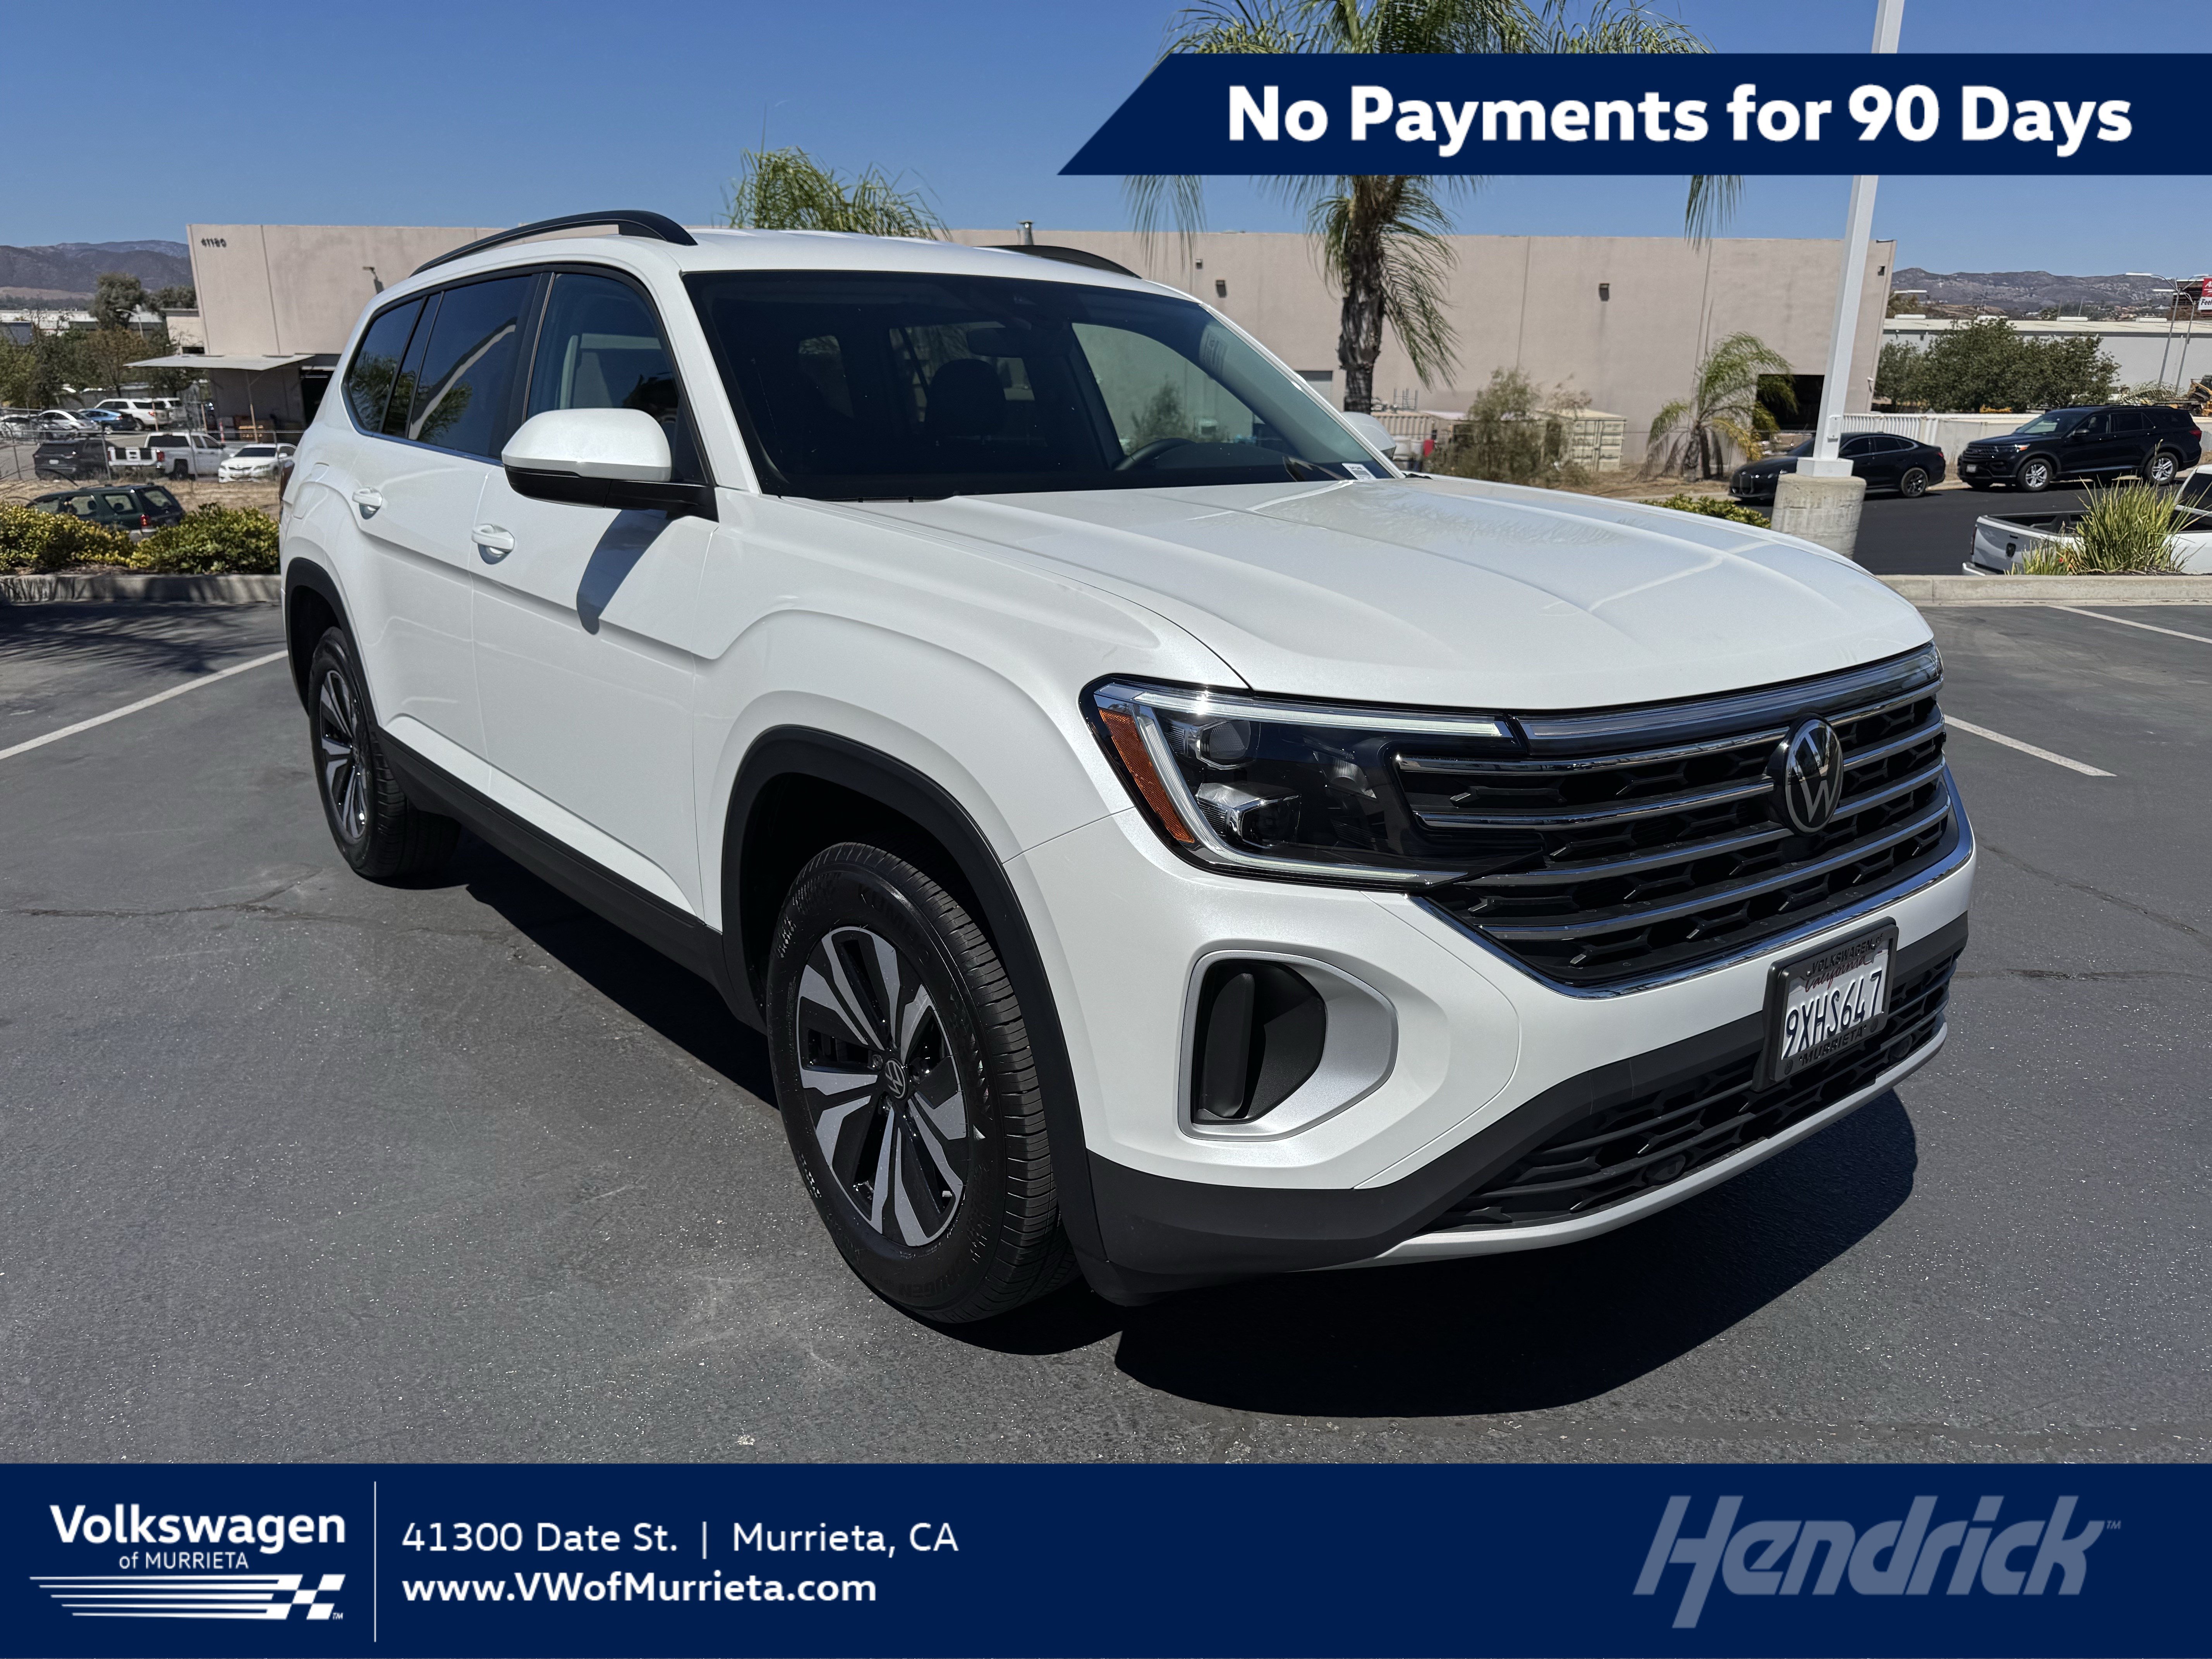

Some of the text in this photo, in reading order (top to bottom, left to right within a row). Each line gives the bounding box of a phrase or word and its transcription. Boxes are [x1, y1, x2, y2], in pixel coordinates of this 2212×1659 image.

[1812, 940, 1873, 974] VOLKSWAGEN
[1782, 967, 1882, 1060] 9XHS647
[1802, 1026, 1863, 1066] MURRIETA
